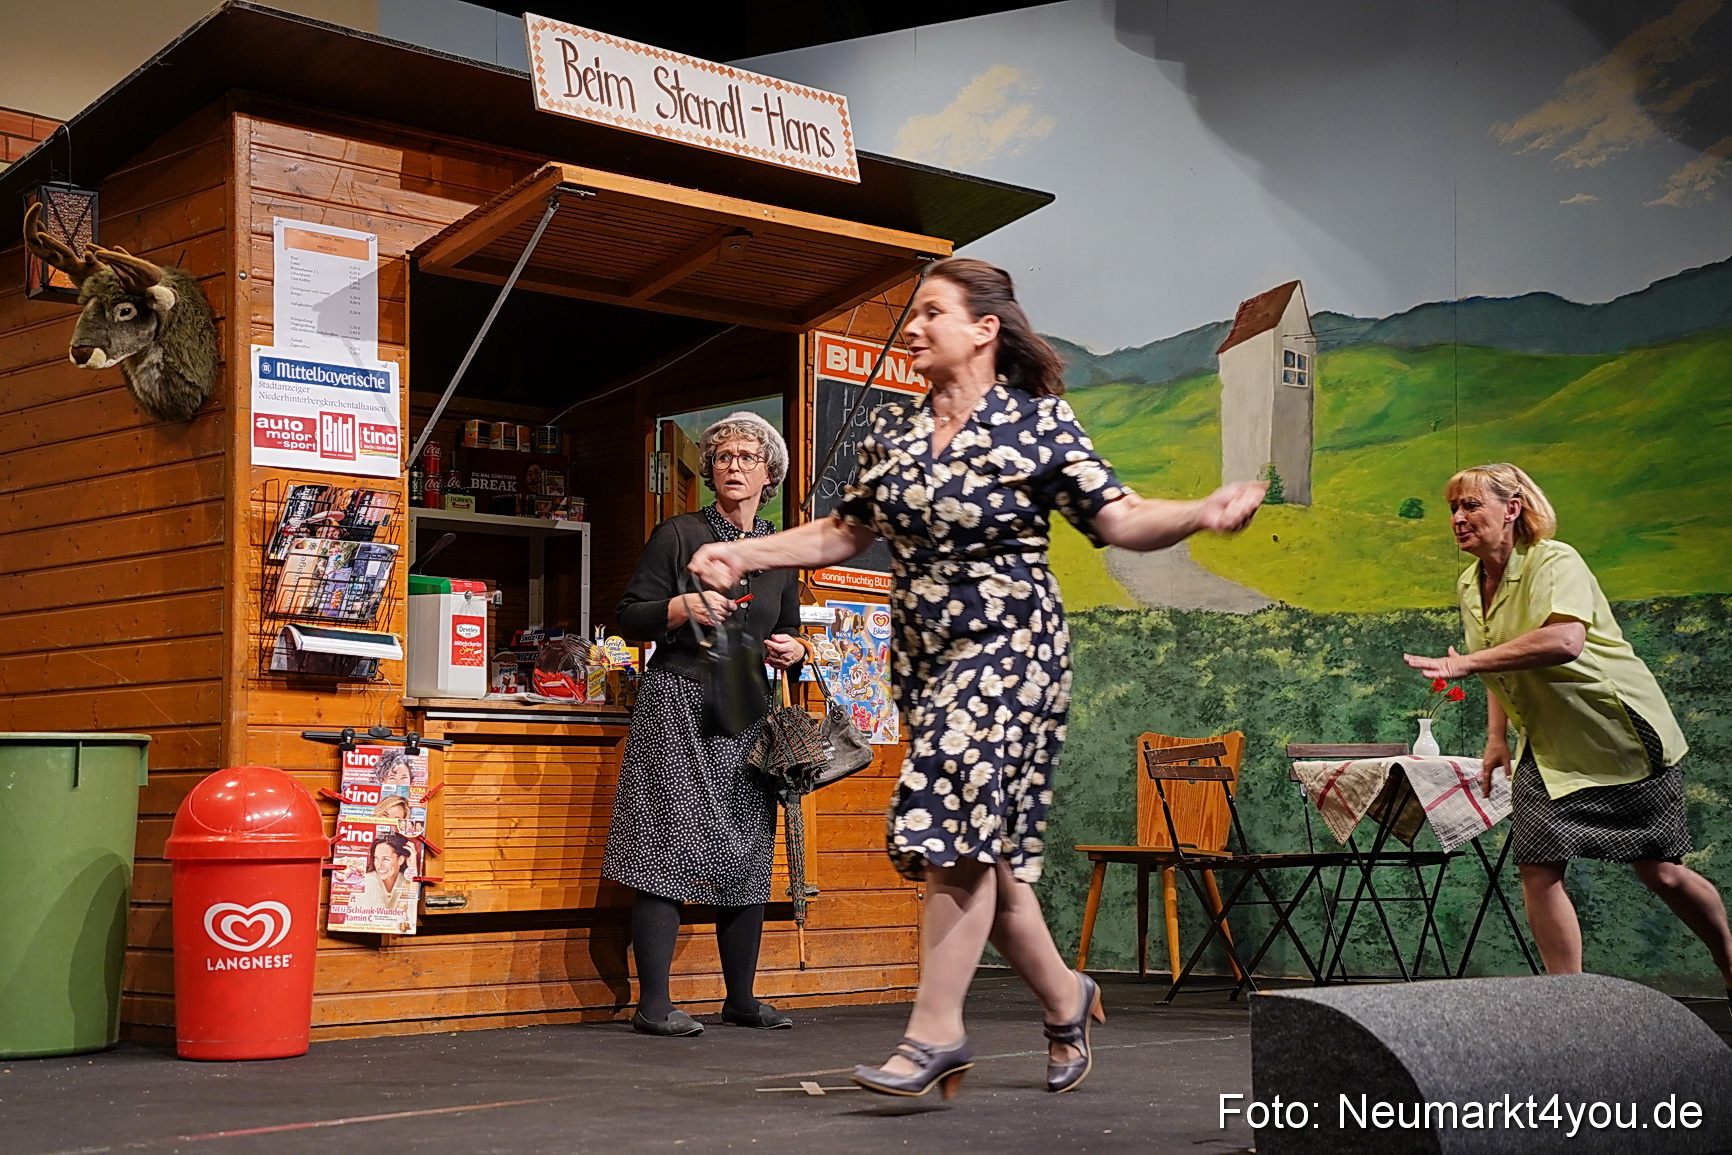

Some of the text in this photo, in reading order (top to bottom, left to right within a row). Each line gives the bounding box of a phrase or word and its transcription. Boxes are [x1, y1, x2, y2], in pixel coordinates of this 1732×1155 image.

[555, 37, 637, 113] Beim
[826, 344, 926, 388] BLUNA
[276, 362, 386, 390] Mittelbayerische
[258, 380, 310, 394] Stadtanzeiger
[258, 392, 386, 412] Niederhinterbergkirchentalhausen
[255, 417, 304, 432] auto
[266, 430, 312, 442] motor
[322, 414, 354, 454] Bild
[362, 426, 396, 446] tina
[470, 478, 518, 492] BREAK
[822, 572, 845, 584] sonnig
[846, 574, 873, 587] fruchtig
[459, 626, 478, 634] Develey
[520, 632, 545, 642] SNICKERS
[515, 652, 540, 662] NICKE
[347, 748, 378, 766] tina
[345, 786, 378, 804] tina
[339, 824, 374, 842] tina
[339, 914, 366, 922] Vtamin
[368, 914, 372, 922] C
[347, 906, 405, 916] Schlank-Wunder
[206, 954, 290, 971] LANGNESE
